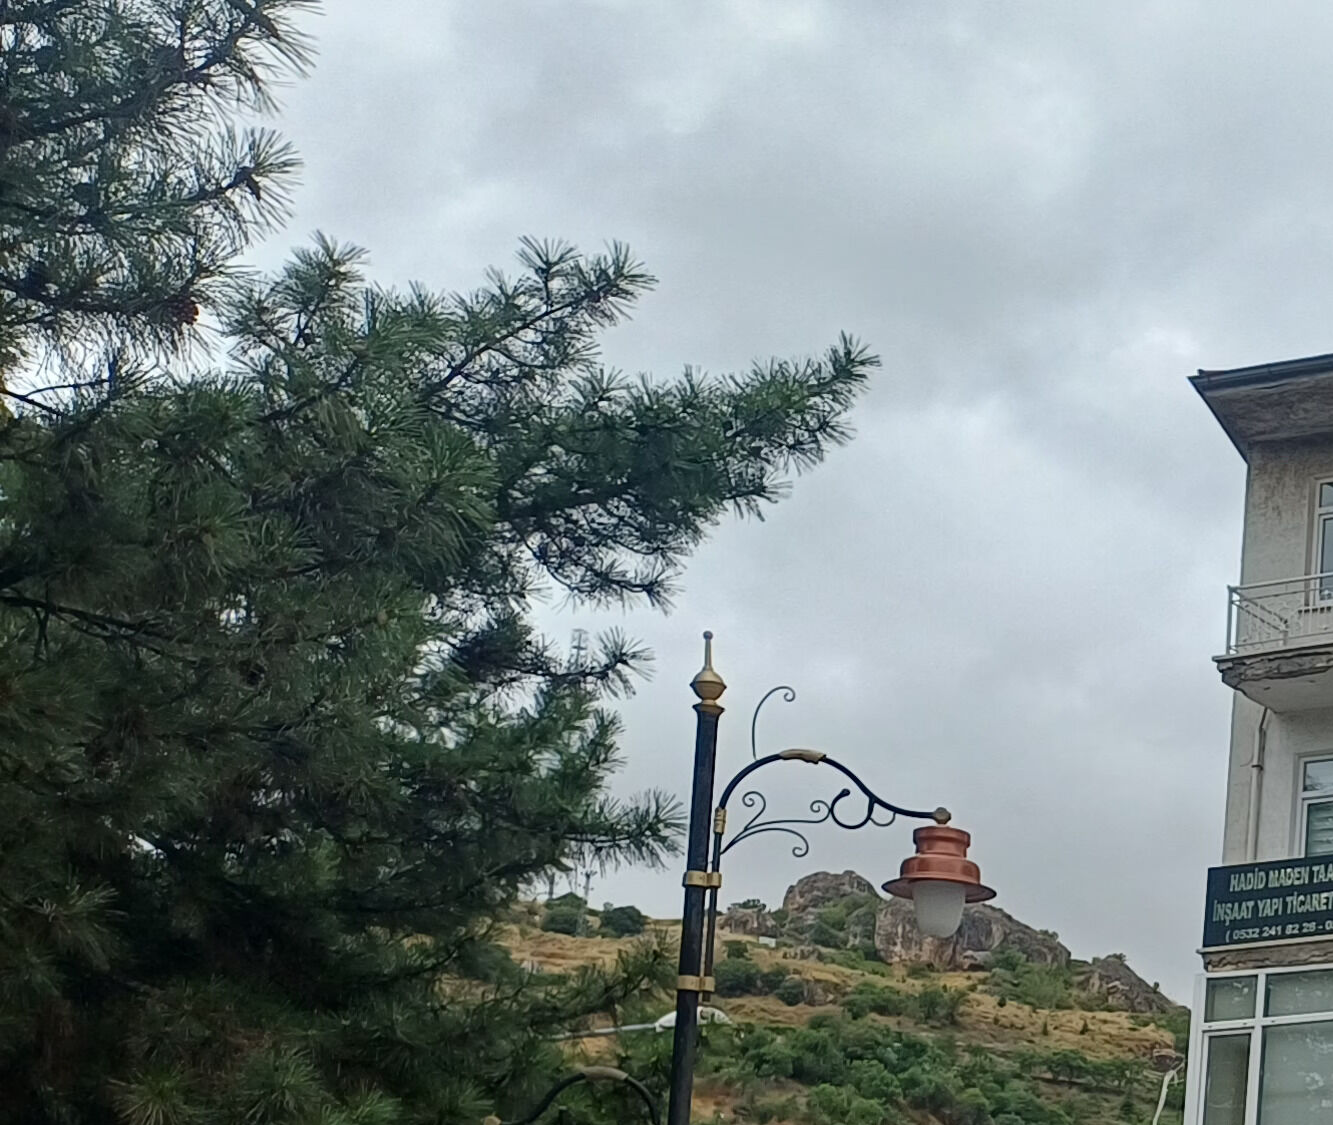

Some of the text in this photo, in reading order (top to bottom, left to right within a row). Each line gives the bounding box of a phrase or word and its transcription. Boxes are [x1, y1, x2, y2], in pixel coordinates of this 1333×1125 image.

[1230, 867, 1265, 892] HADİD
[1268, 866, 1309, 888] MADEN
[1213, 898, 1254, 926] İNŞAAT
[1257, 896, 1283, 918] YAPI
